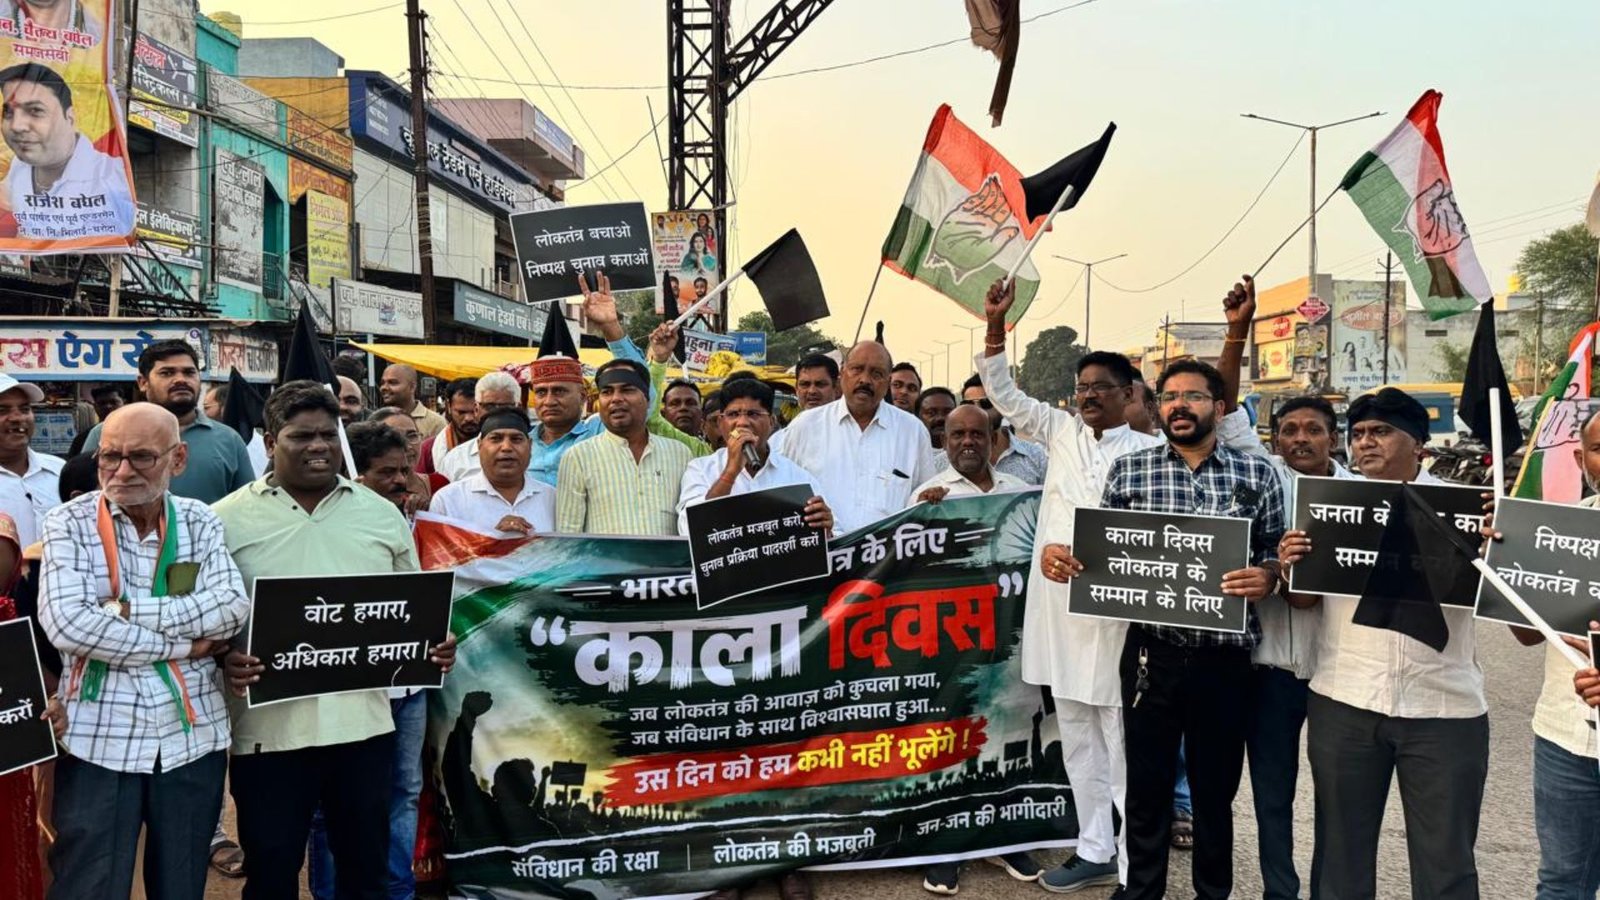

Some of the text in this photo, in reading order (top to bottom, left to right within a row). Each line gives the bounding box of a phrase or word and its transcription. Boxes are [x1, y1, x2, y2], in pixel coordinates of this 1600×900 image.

[24, 192, 106, 209] राजेश बघेल
[534, 226, 584, 248] लोकतंत्र
[588, 221, 631, 240] बचाओ
[525, 260, 566, 279] निष्पक्ष
[570, 255, 606, 275] चुनाव
[465, 299, 497, 322] कुणाल
[707, 511, 805, 545] लोकतंत्र मजबूत करो,
[1309, 503, 1364, 525] जनता
[1105, 523, 1215, 554] काला दिवस
[1534, 525, 1600, 560] निष्पक्ष
[620, 576, 698, 601] भारत
[861, 533, 888, 565] के
[893, 523, 949, 561] लिए
[700, 556, 724, 577] चुनाव
[727, 548, 759, 566] प्रक्रिया
[1107, 551, 1208, 582] लोकतंत्र के
[1497, 560, 1581, 597] लोकतंत्र
[304, 597, 412, 625] वोट हमारा,
[1090, 584, 1224, 620] सम्मान के लिए
[271, 642, 360, 671] अधिकार
[629, 672, 941, 722] जब लोकतंत्र की आवाज़ को कुचला गया,
[631, 730, 661, 746] जब
[664, 723, 732, 744] संविधान
[736, 719, 755, 739] के
[759, 716, 796, 736] साथ
[800, 702, 892, 731] विश्वासघात
[634, 768, 670, 794] उस
[676, 759, 717, 788] दिन
[722, 754, 754, 781] को
[759, 754, 793, 781] हम
[797, 738, 846, 772] कभी
[851, 733, 895, 768] नहीं
[898, 726, 957, 771] भूलेंगे
[916, 795, 1068, 836] जन-जन की भागीदारी
[713, 826, 877, 864] लोकतंत्र की मजबूती
[512, 849, 660, 879] संविधान की रक्षा
